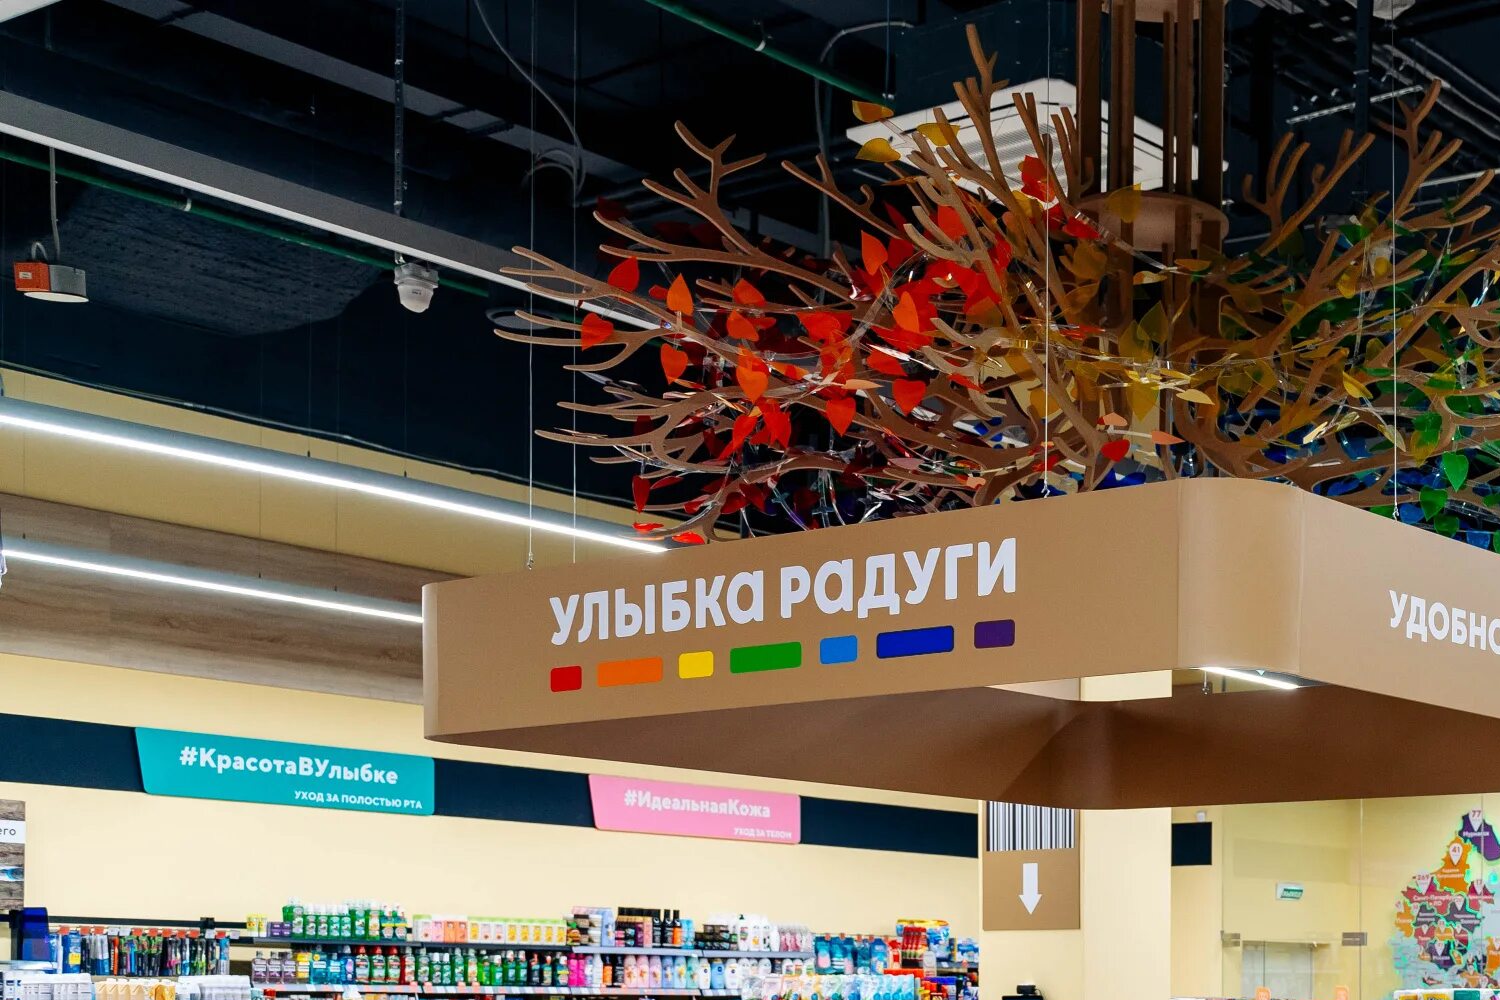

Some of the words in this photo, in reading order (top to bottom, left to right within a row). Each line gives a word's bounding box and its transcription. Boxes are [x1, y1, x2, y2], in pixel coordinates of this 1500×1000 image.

[179, 745, 399, 786] #КрасотаВУлыбке
[294, 790, 325, 804] УХОД
[326, 793, 340, 804] ЗА
[341, 794, 402, 808] ПОЛОСТЬЮ
[403, 798, 423, 810] РТА
[623, 789, 771, 819] #ИдеальнаяКожа
